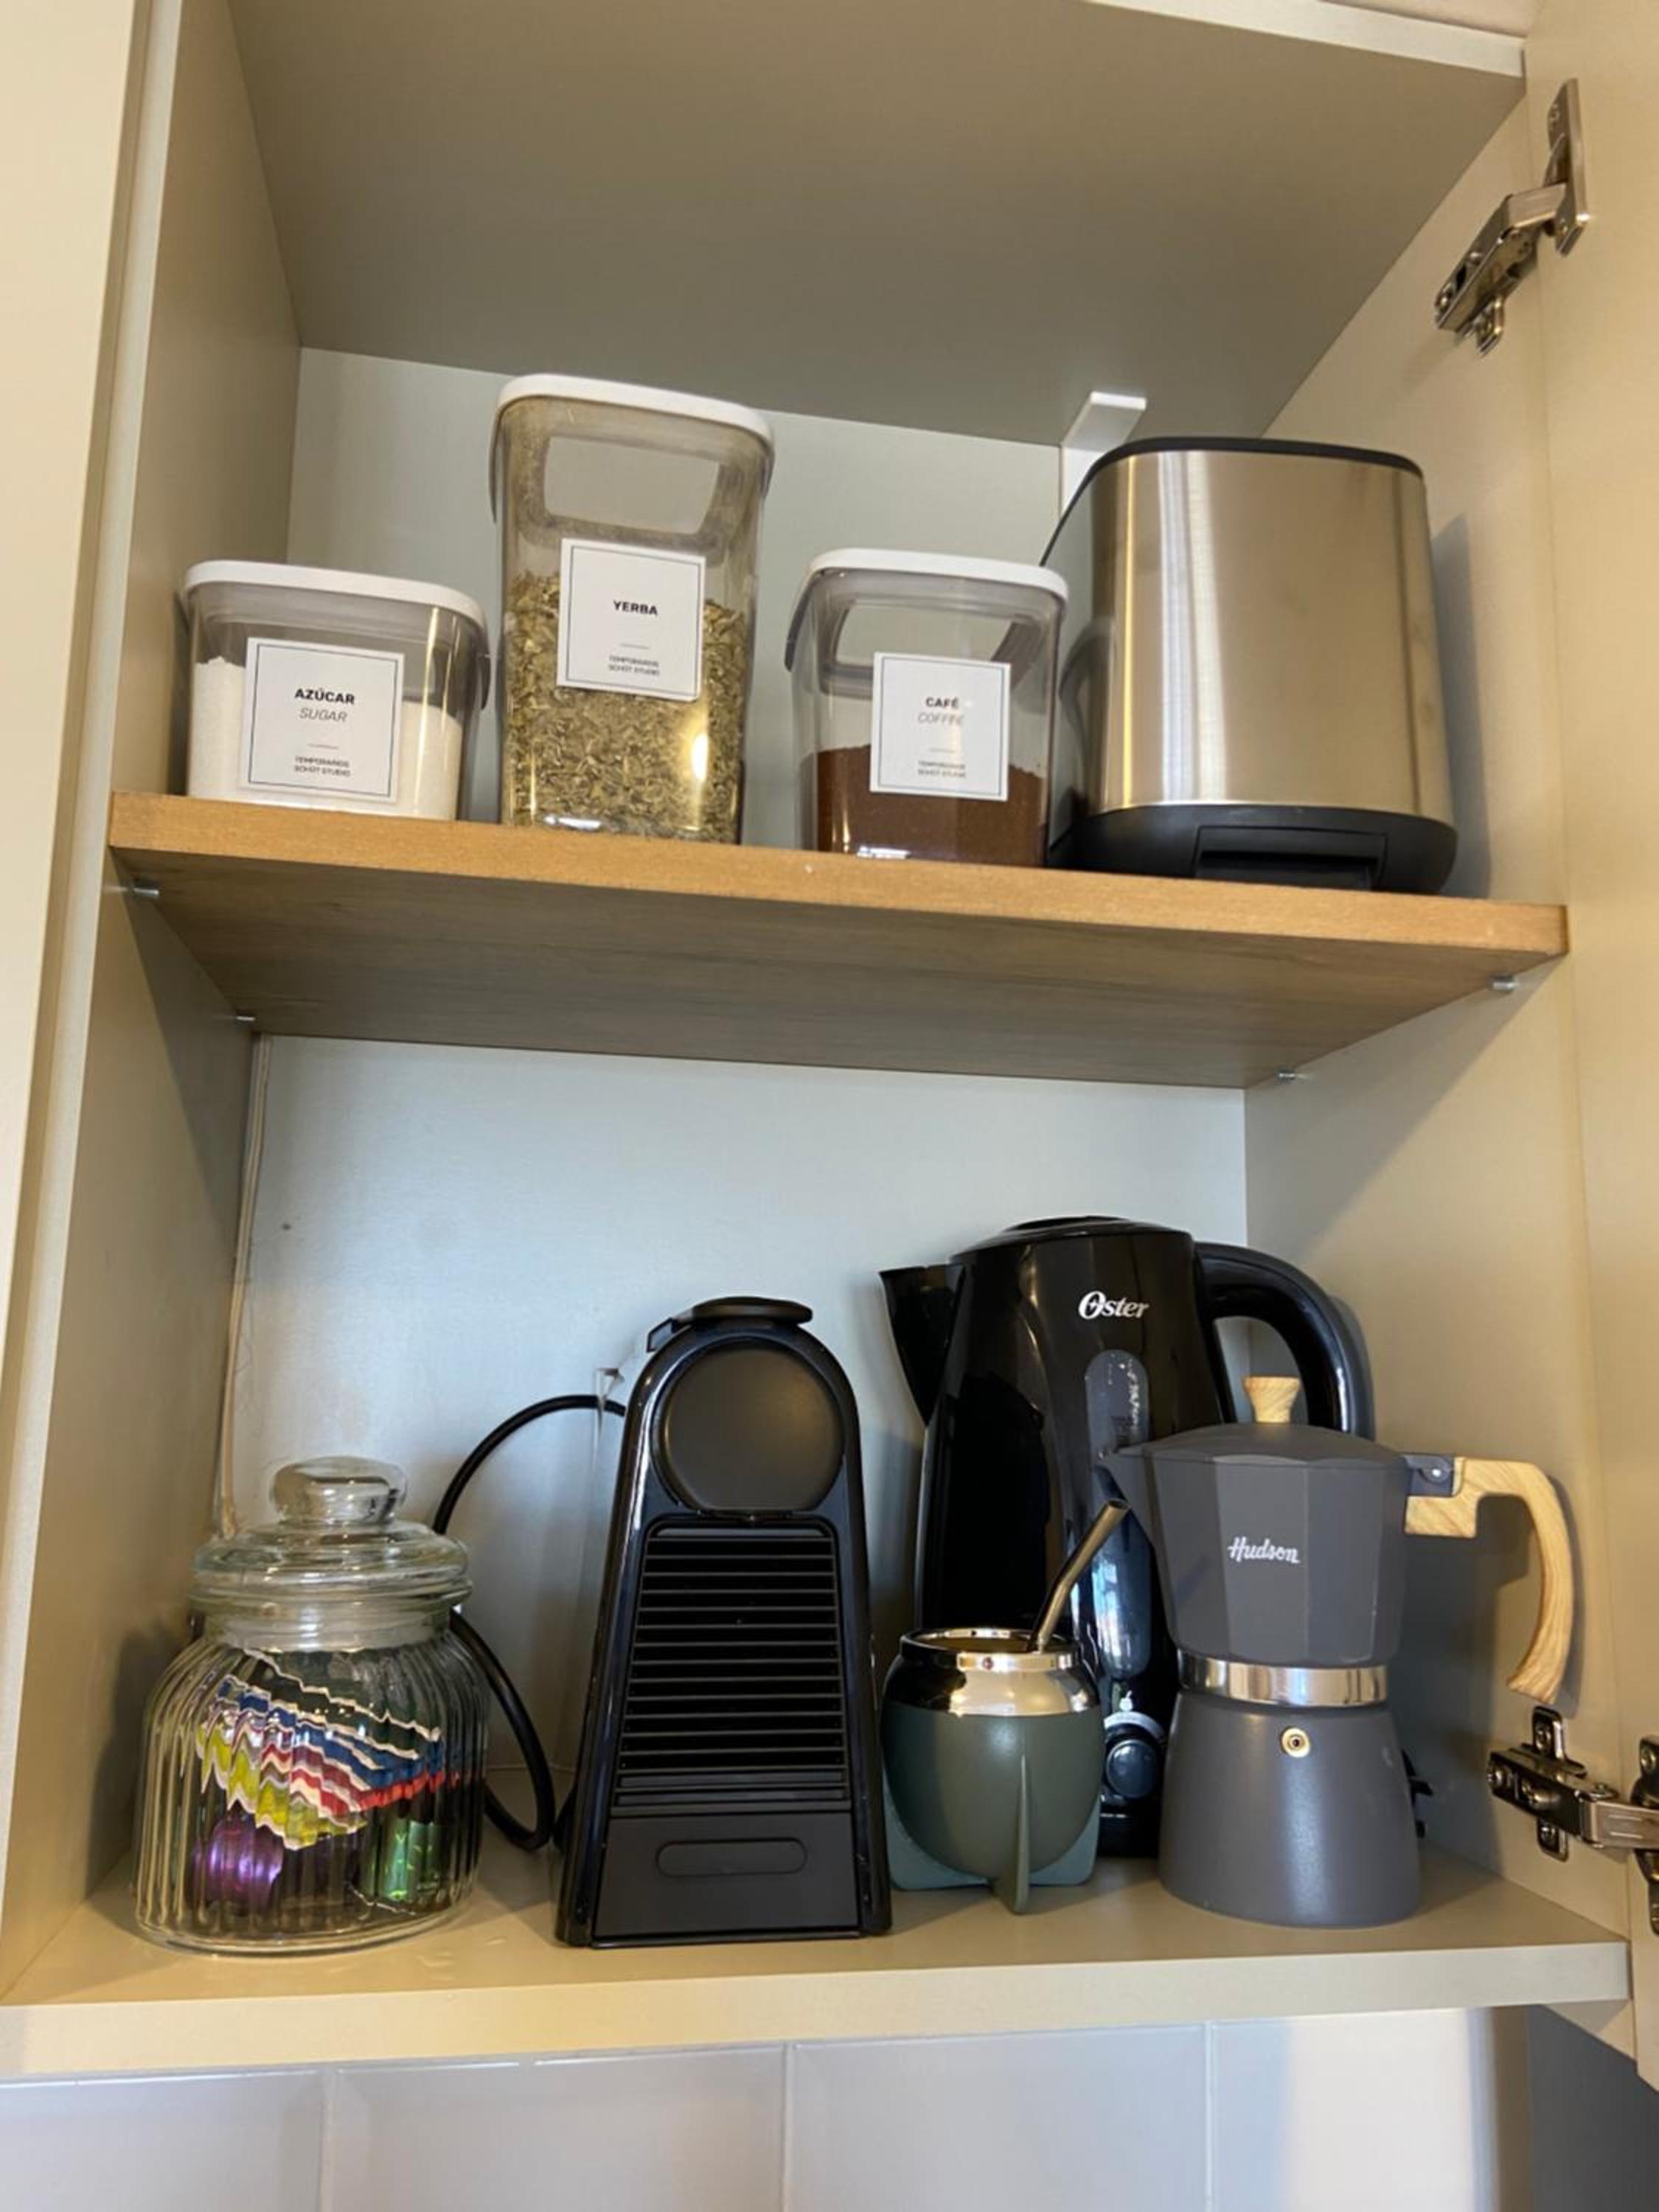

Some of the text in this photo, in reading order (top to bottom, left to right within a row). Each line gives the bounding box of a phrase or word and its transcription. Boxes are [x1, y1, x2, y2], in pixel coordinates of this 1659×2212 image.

[613, 600, 658, 616] YERBA
[295, 688, 355, 705] AZÚCAR
[925, 696, 959, 709] CAFÉ
[299, 707, 347, 723] SUGAR
[1078, 1290, 1150, 1319] Oster
[1227, 1536, 1301, 1564] Hudson
